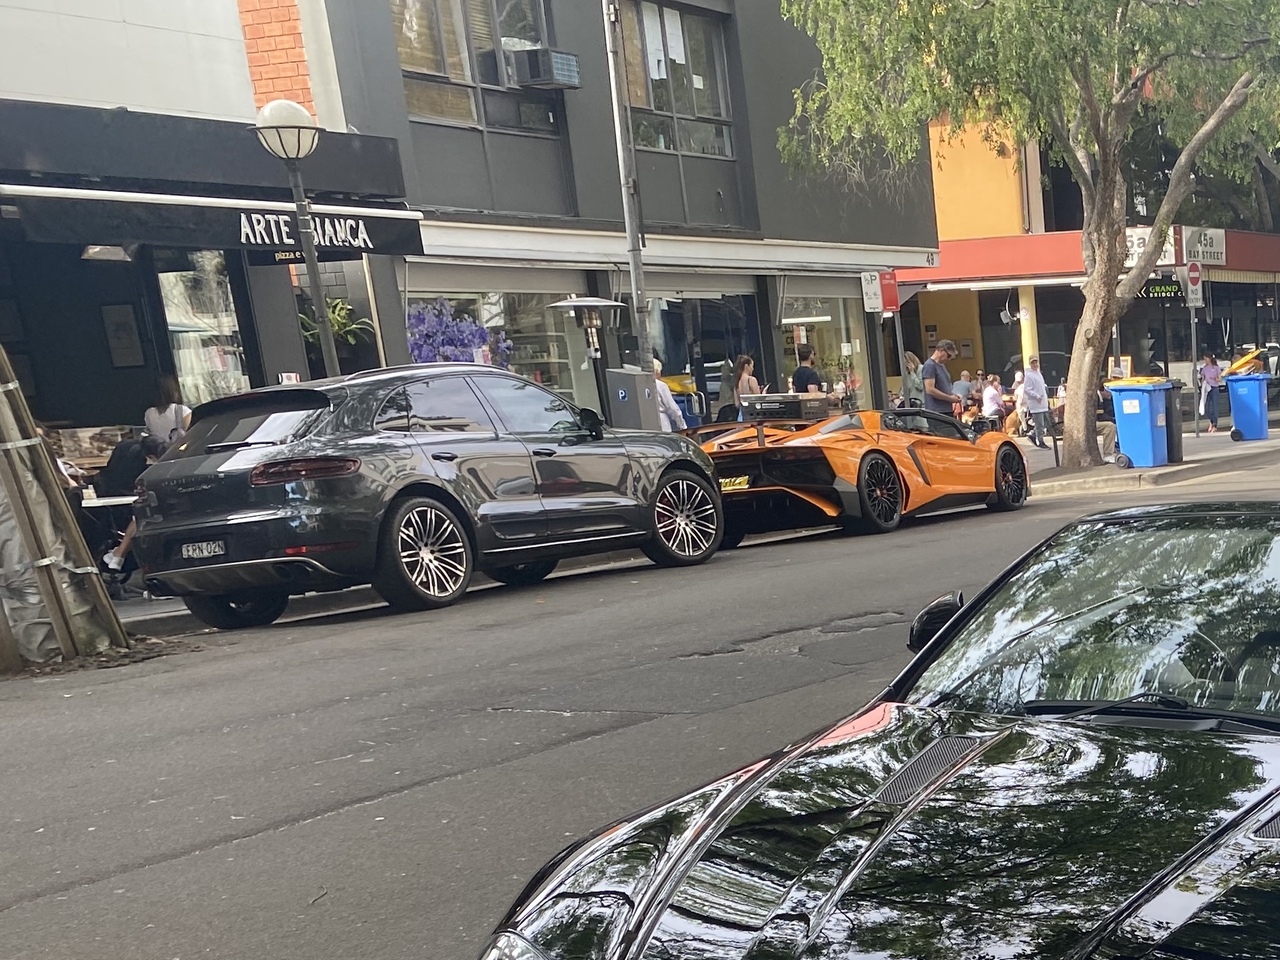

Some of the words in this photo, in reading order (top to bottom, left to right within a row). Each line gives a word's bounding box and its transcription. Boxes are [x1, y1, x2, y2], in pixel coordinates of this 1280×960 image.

[240, 212, 295, 245] ARTE
[309, 214, 374, 248] BIANCA
[1197, 232, 1214, 248] 45a
[274, 250, 295, 262] pizza
[1188, 250, 1200, 259] BAY
[1202, 251, 1224, 260] STREET
[1149, 285, 1178, 293] GRAND
[1190, 288, 1198, 296] NO
